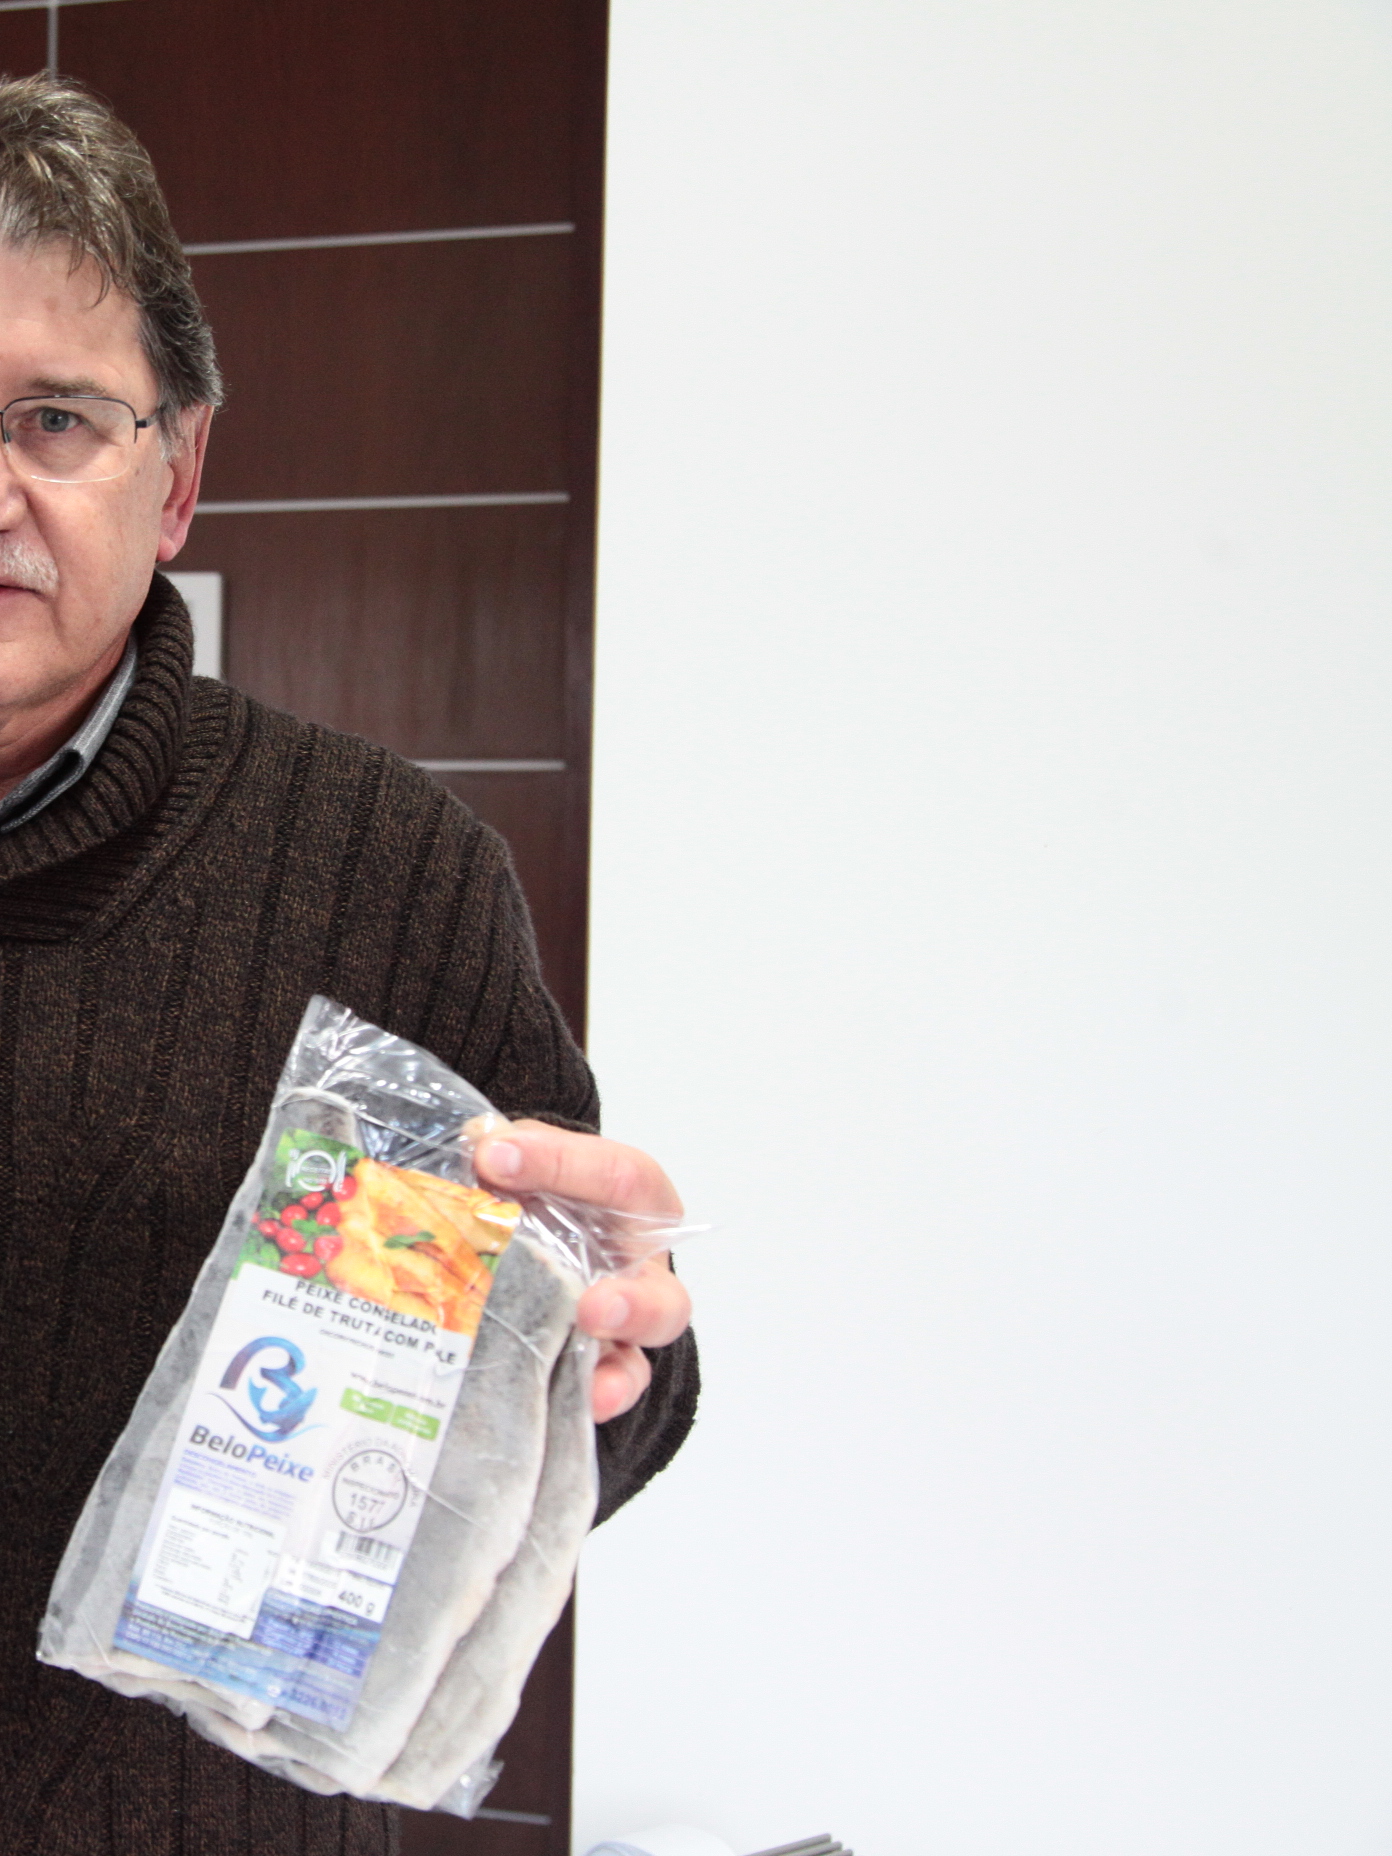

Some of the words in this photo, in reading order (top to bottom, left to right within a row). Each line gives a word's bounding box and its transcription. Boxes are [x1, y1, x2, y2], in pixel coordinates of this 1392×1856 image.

[295, 1280, 343, 1304] PEIXE
[262, 1289, 298, 1310] FILÉ
[302, 1302, 325, 1318] DE
[383, 1330, 419, 1348] COM
[189, 1424, 314, 1482] BeloPeixe
[338, 1590, 363, 1608] 400
